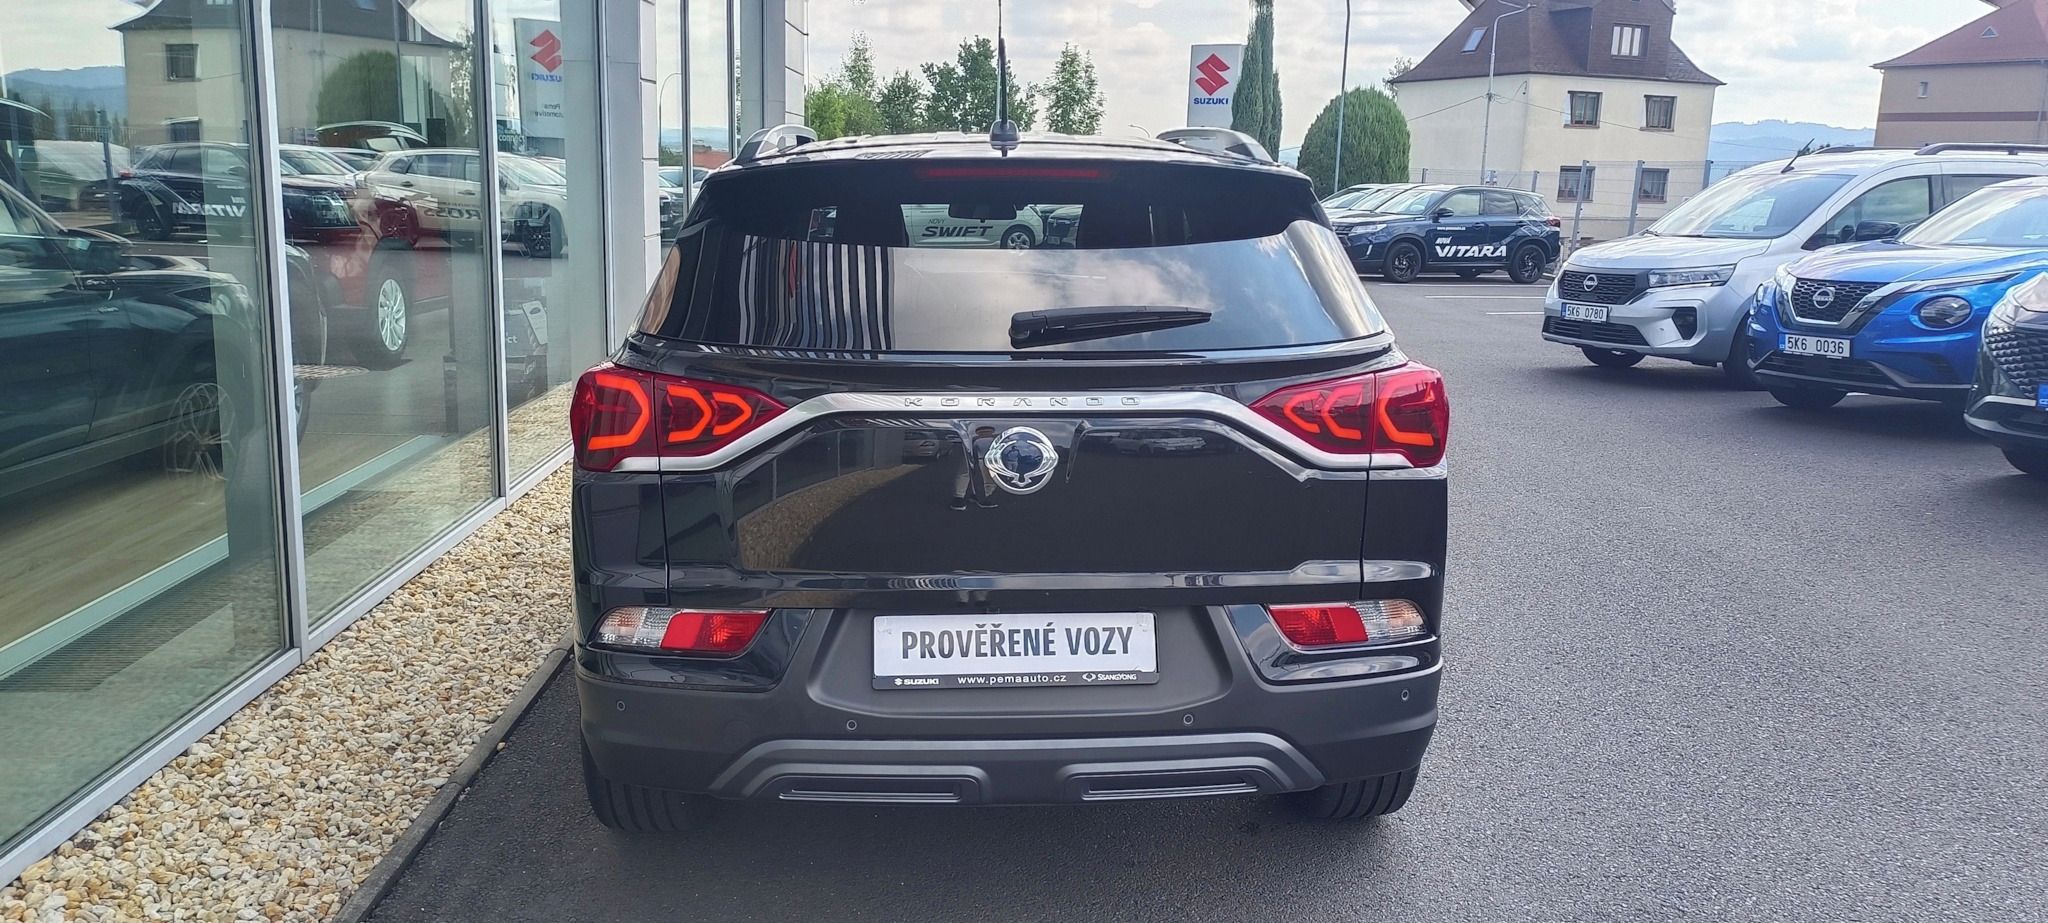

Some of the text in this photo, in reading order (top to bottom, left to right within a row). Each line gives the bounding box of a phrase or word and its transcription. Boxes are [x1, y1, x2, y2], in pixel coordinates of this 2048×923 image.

[1193, 97, 1229, 105] SUZUKI
[921, 226, 994, 237] SWIFT
[1435, 245, 1507, 257] VITARA
[1567, 306, 1604, 319] 5K6 0780
[1787, 336, 1844, 354] 5K6 0036
[904, 397, 1141, 408] KORANDO
[902, 622, 1133, 659] PROVĚŘENÉ VOZY
[903, 678, 940, 686] SUZUKI
[957, 674, 1067, 686] www.pemaauto.cz
